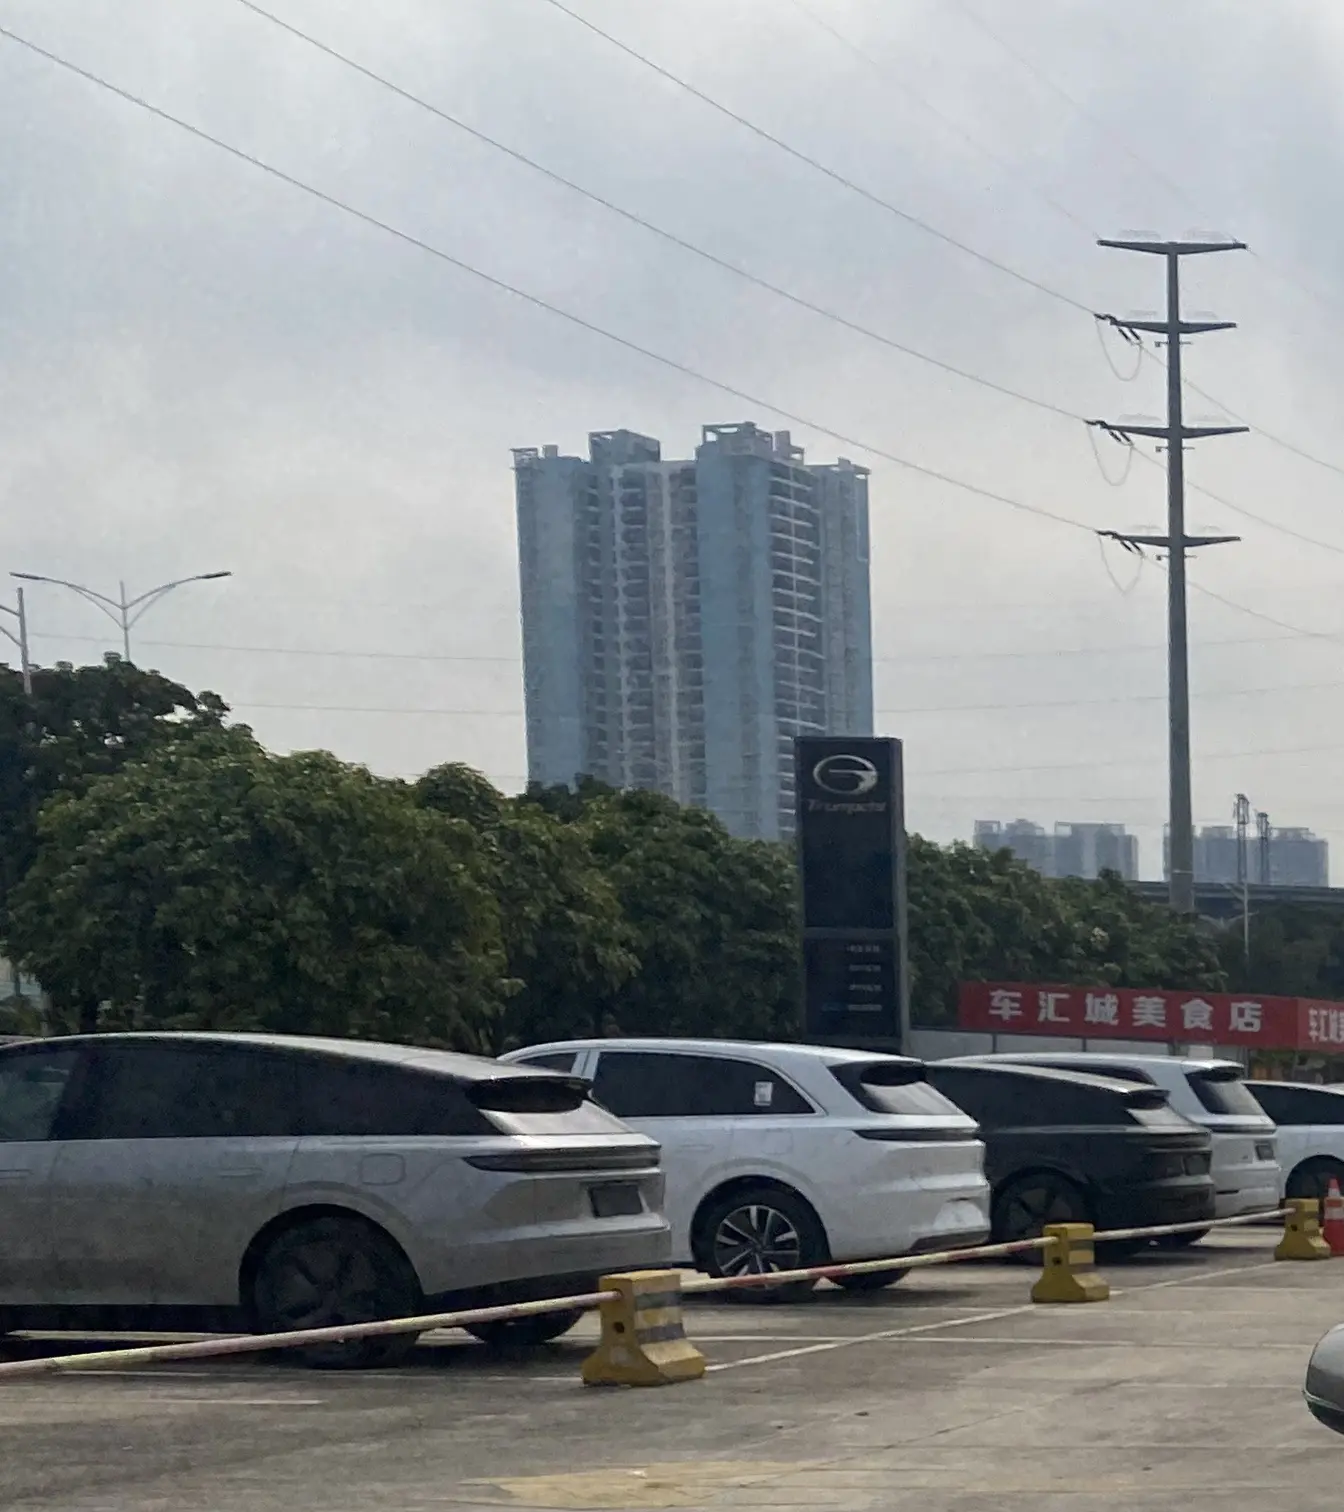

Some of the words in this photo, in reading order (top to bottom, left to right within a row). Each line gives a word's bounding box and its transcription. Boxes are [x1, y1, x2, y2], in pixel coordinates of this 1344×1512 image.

[988, 989, 1262, 1033] 车汇城美食店
